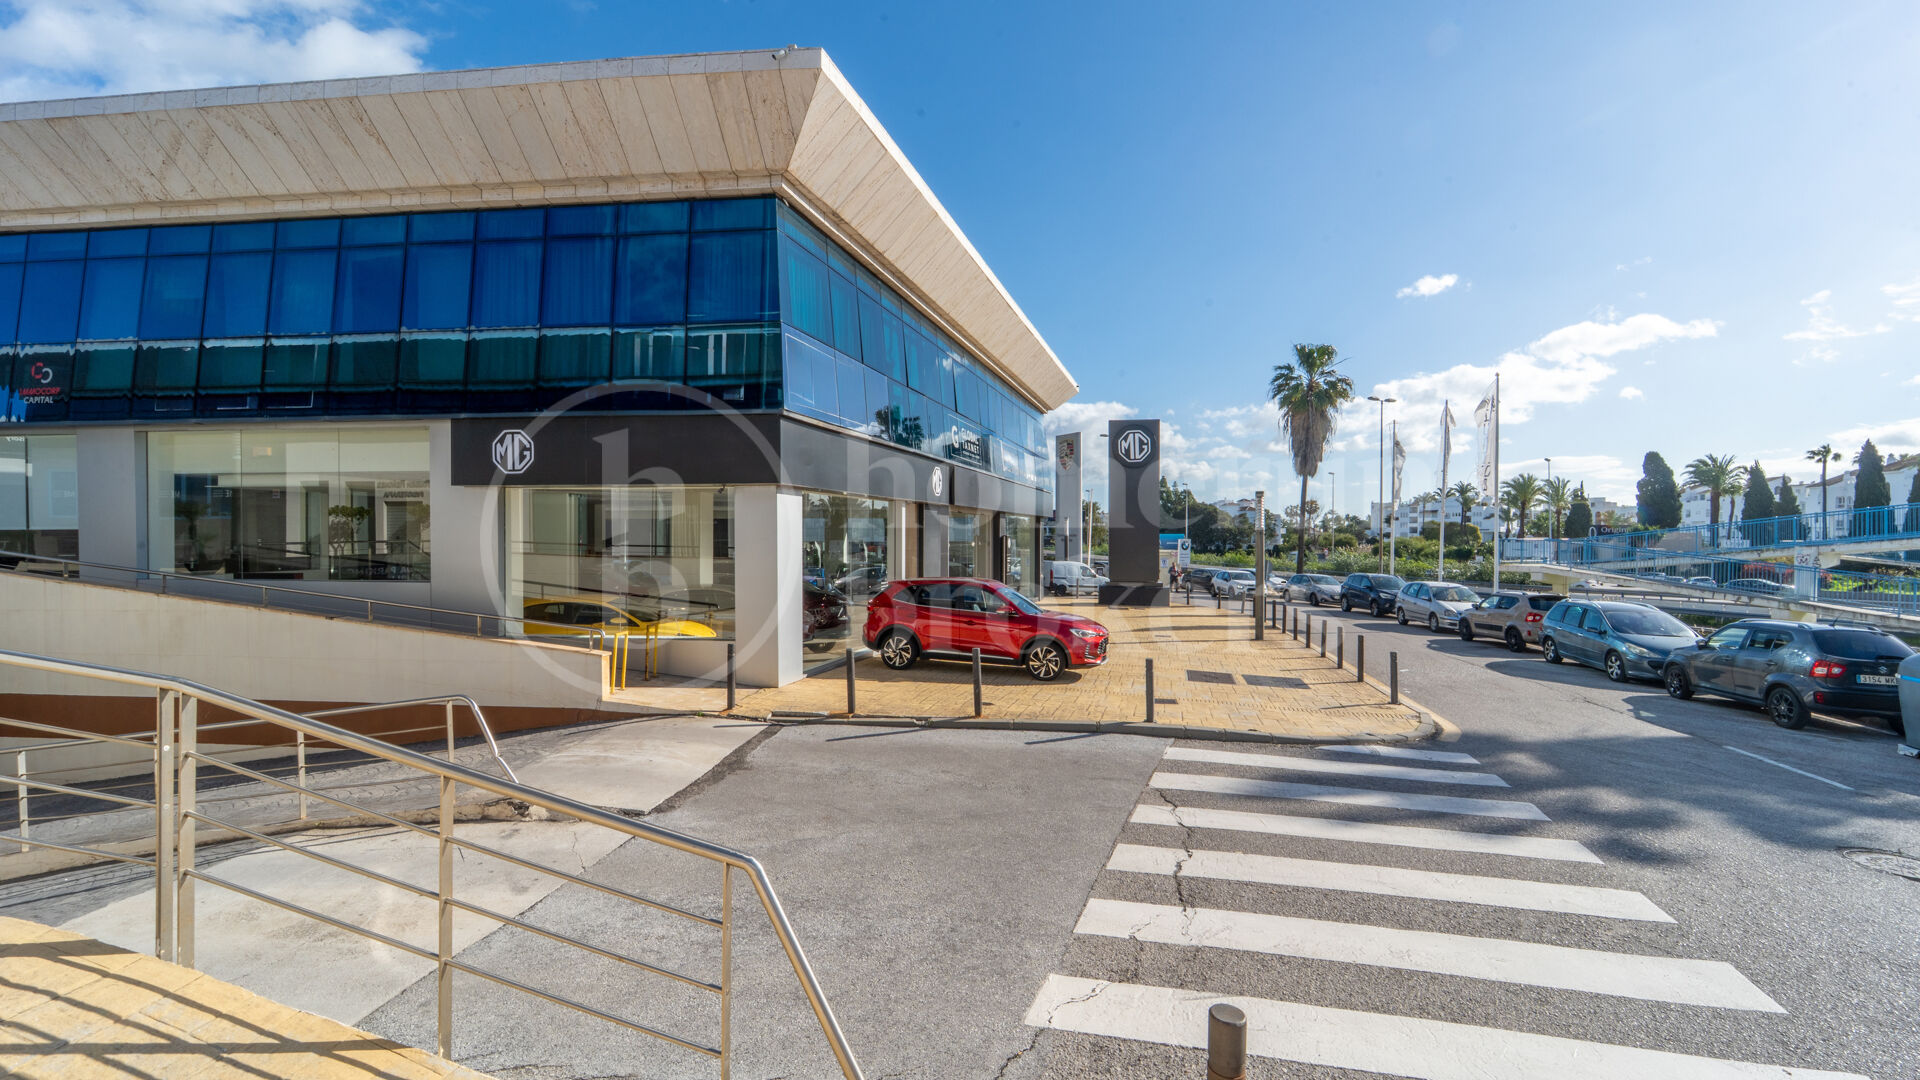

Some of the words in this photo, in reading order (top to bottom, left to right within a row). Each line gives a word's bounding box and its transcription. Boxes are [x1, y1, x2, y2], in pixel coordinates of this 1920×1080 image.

[23, 396, 54, 404] CAPITAL
[495, 432, 532, 471] MG
[1120, 431, 1149, 460] MG
[932, 467, 943, 495] MG
[1862, 675, 1882, 684] 3154
[1884, 677, 1897, 686] MK
